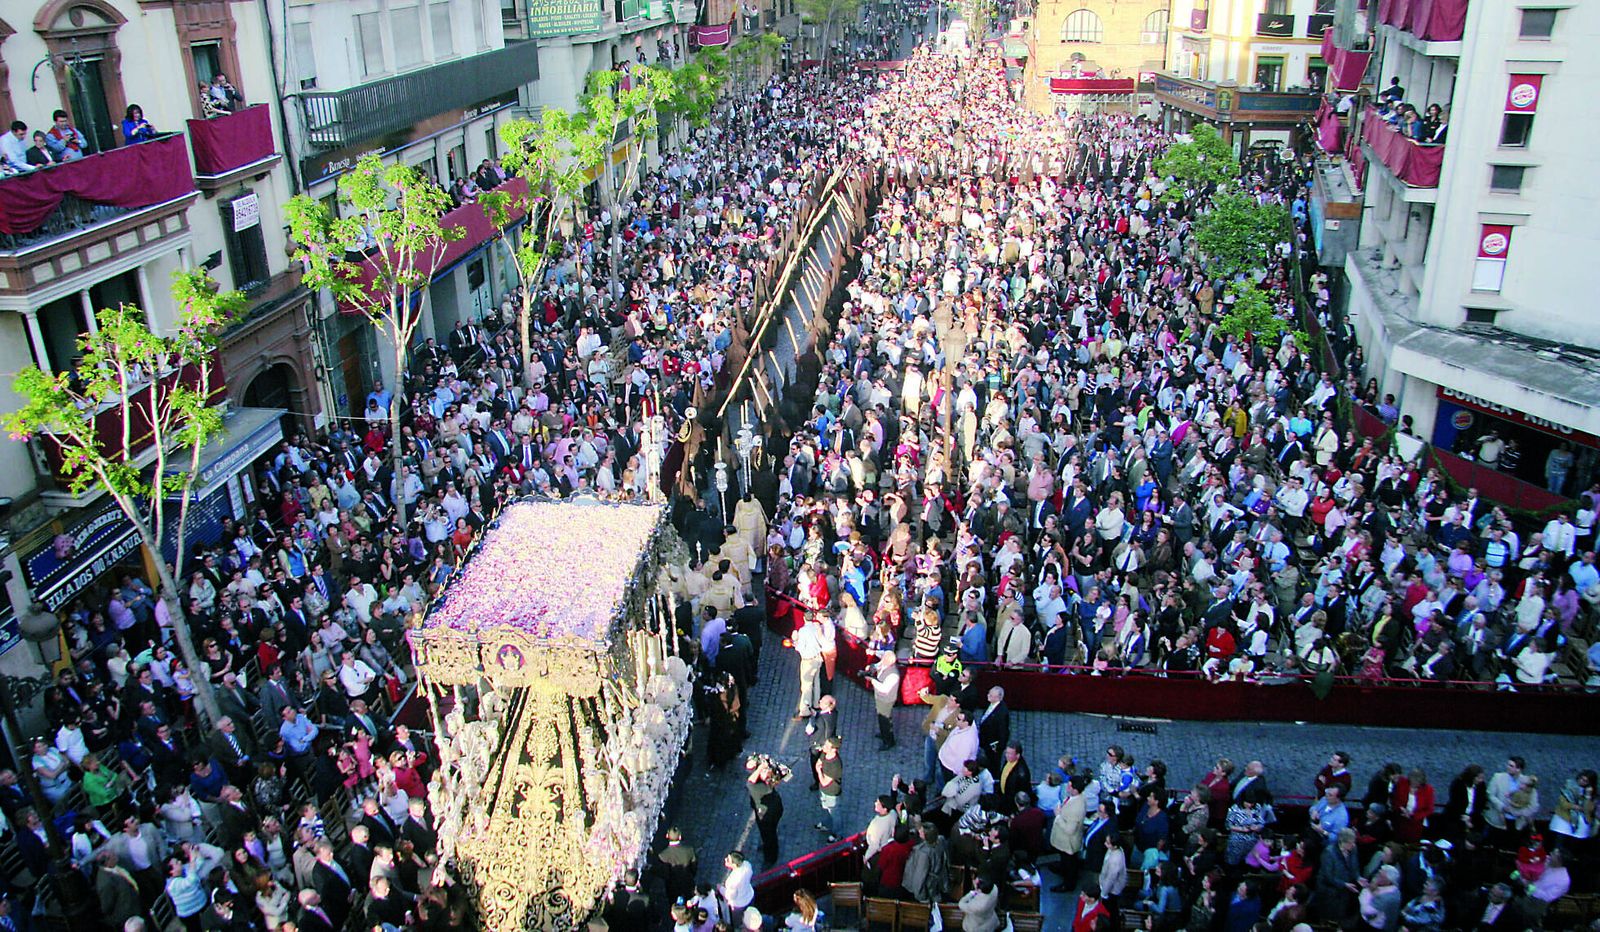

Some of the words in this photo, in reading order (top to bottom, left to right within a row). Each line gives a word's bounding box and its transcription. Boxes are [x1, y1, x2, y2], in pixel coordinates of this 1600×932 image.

[530, 3, 599, 16] INMOBILIARIA
[214, 443, 249, 472] Campana
[46, 568, 93, 612] HELADOS
